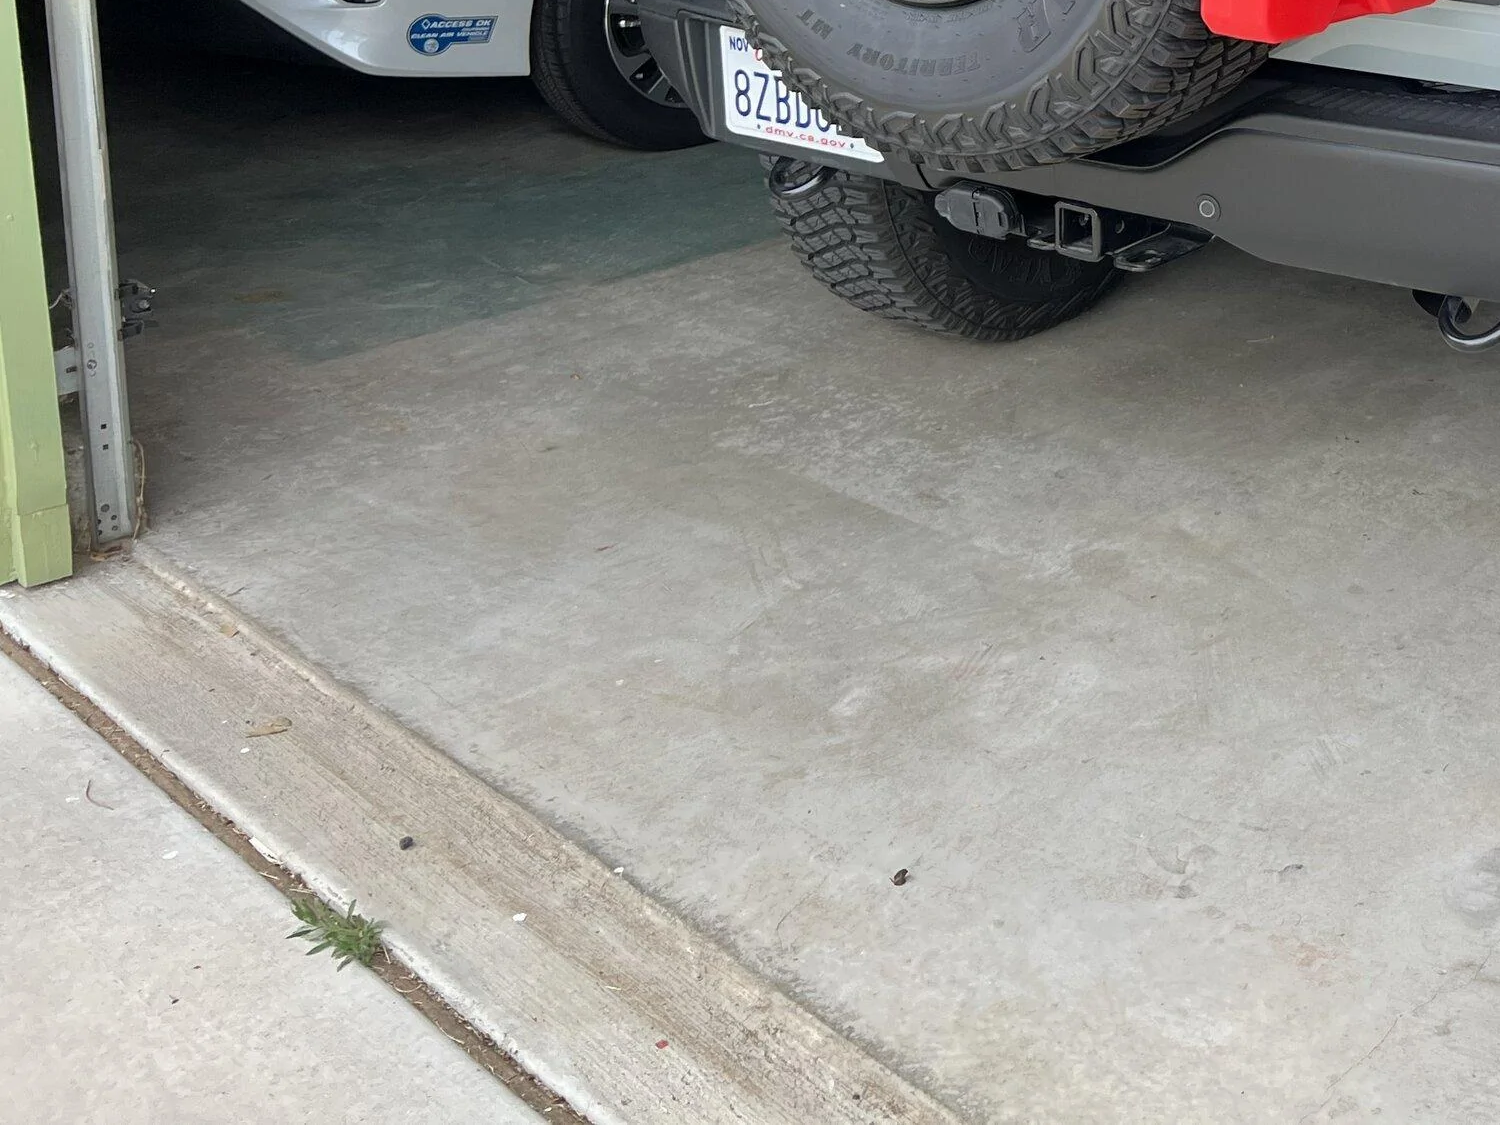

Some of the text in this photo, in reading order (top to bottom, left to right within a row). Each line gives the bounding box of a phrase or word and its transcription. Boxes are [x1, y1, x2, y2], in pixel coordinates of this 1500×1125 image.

[430, 20, 473, 28] ACCESS
[729, 36, 749, 52] NOV
[847, 42, 981, 76] TERRITORY
[765, 126, 846, 148] dmv.ca.gov
